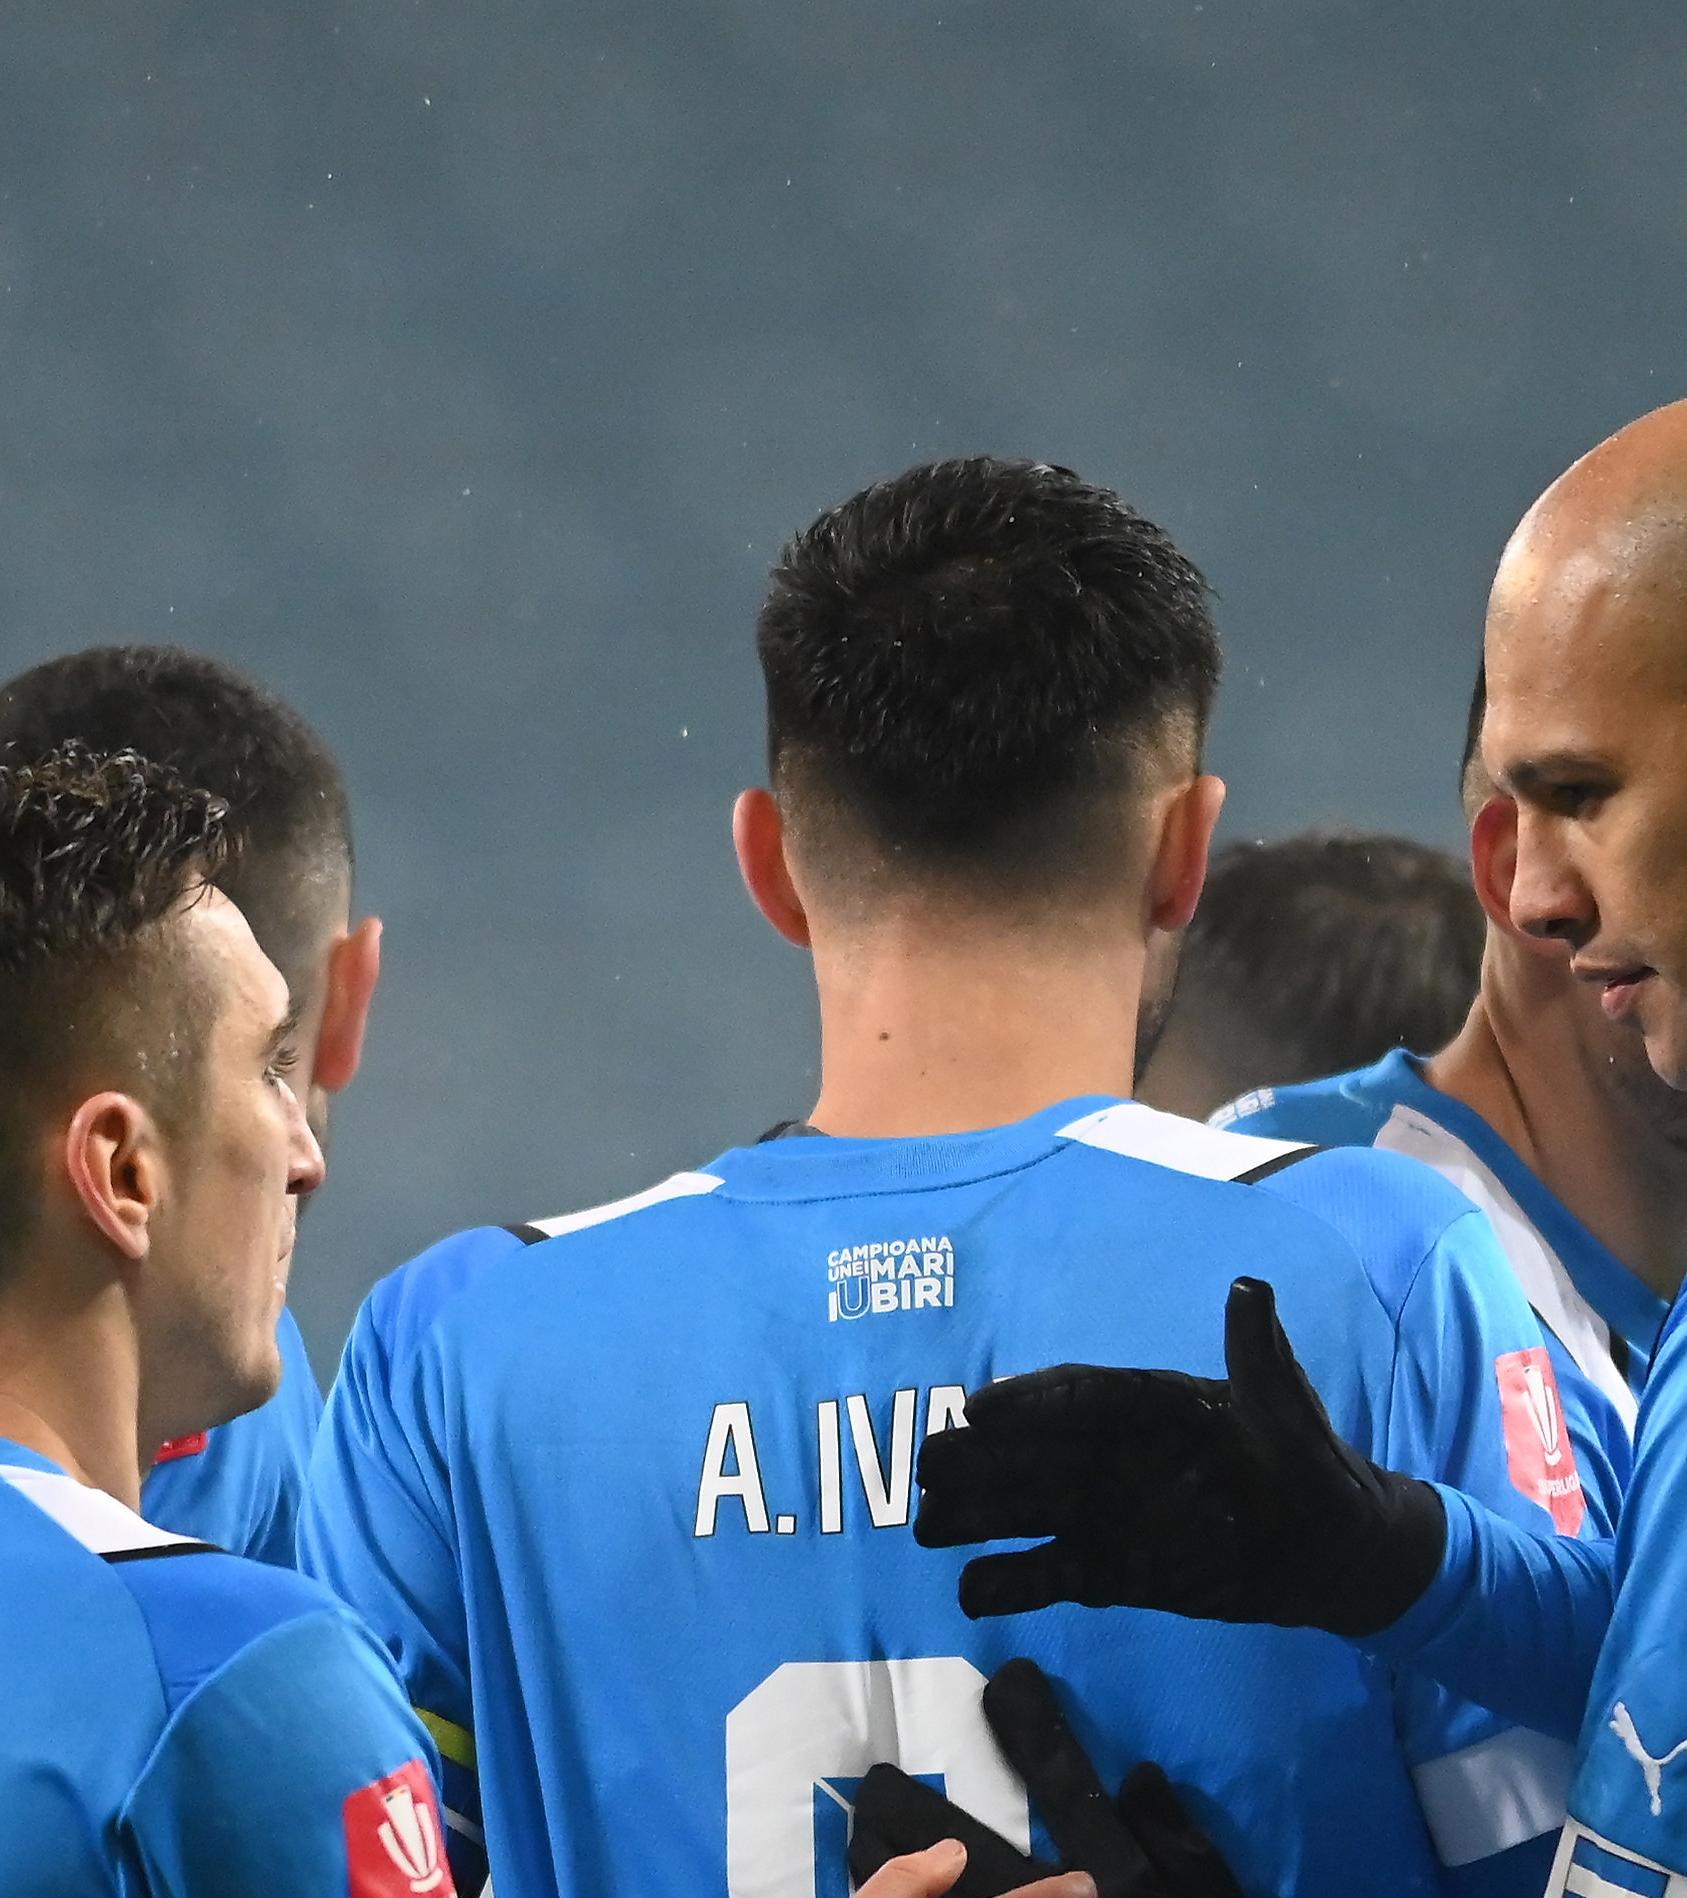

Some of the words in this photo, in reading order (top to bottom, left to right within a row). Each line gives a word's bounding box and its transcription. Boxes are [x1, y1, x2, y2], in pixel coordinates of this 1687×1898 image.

[827, 1236, 954, 1268] CAMPIOANA
[827, 1259, 870, 1283] UNEI
[870, 1252, 955, 1283] MARI
